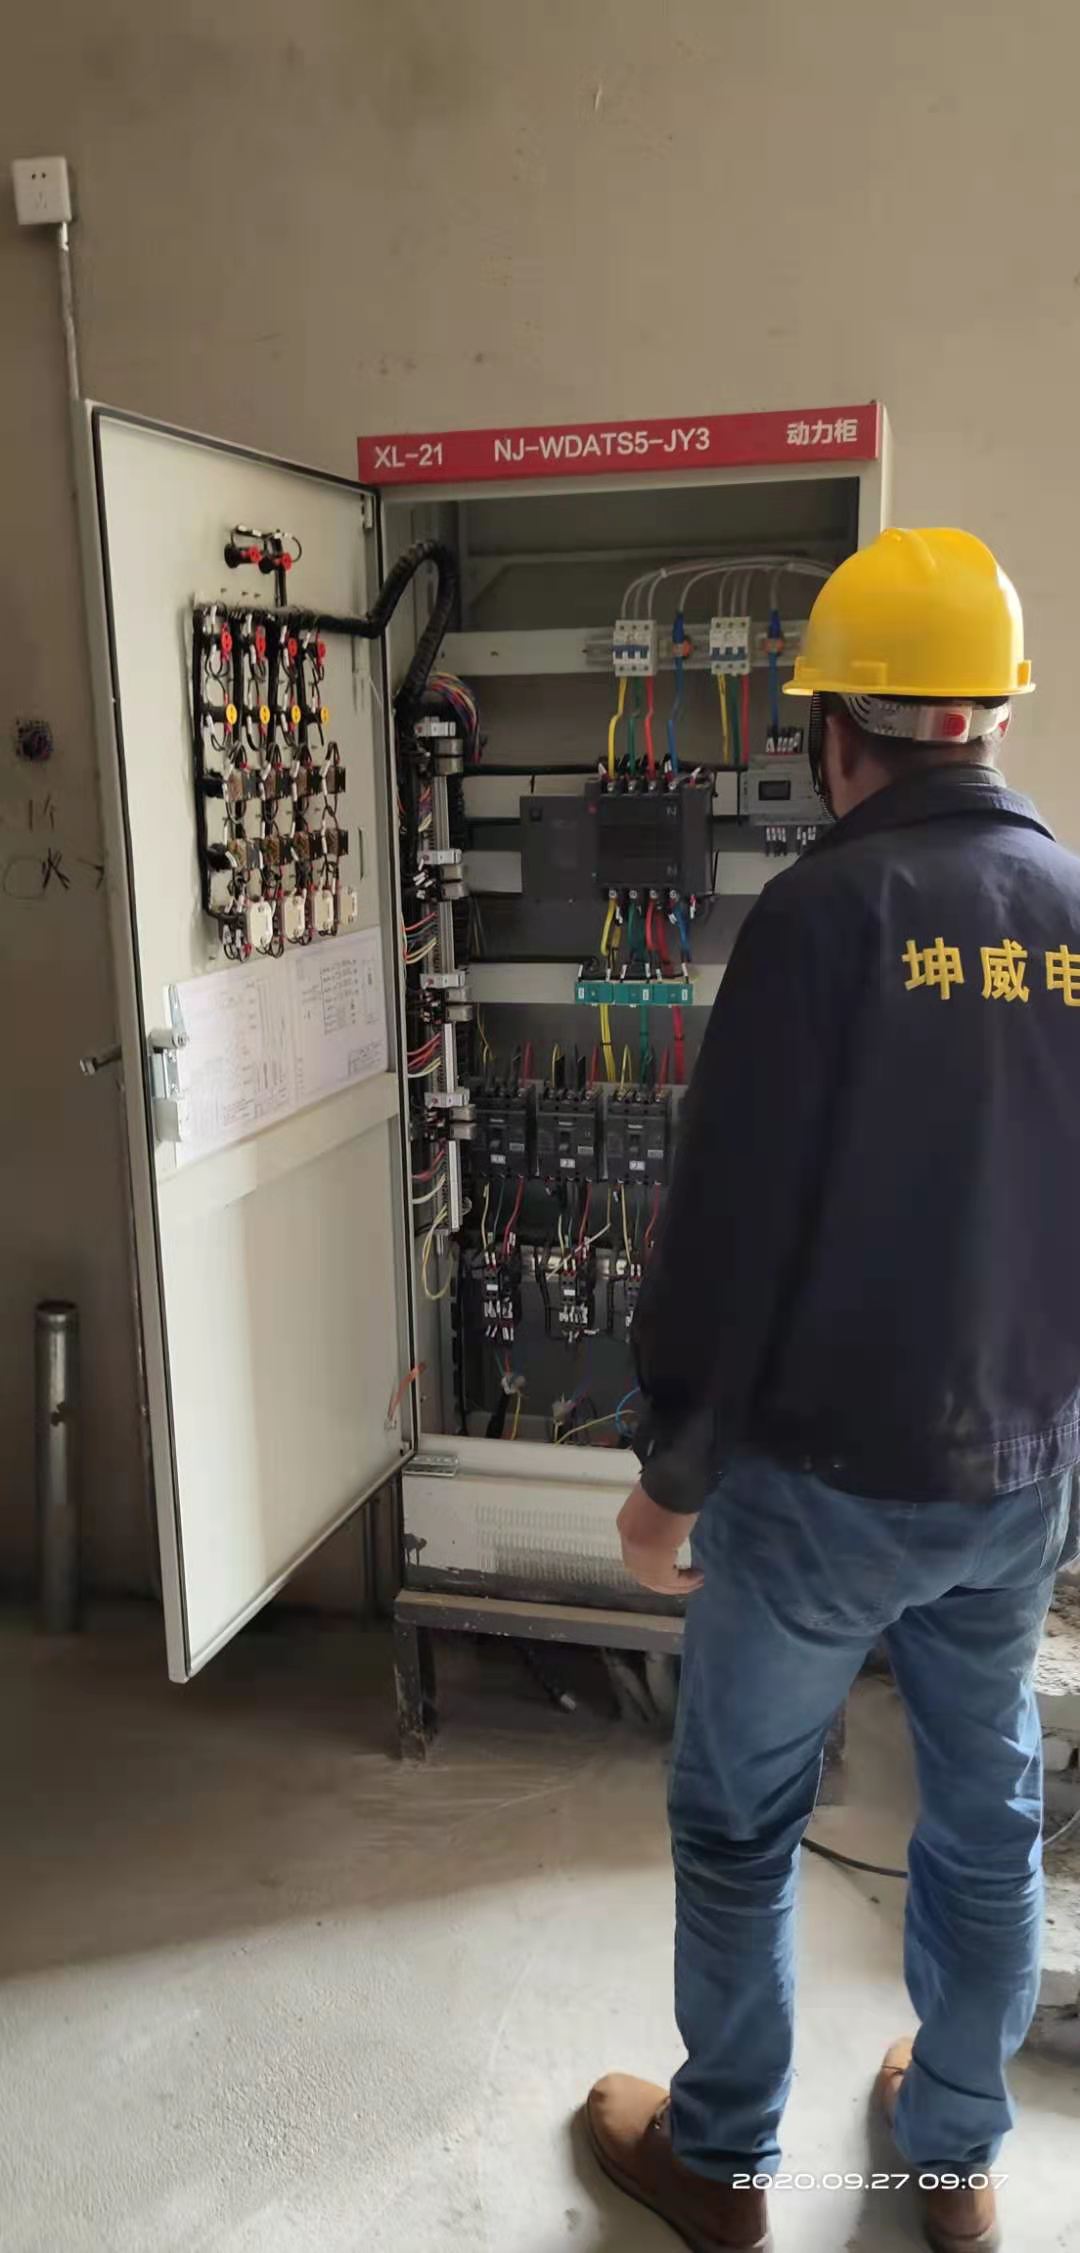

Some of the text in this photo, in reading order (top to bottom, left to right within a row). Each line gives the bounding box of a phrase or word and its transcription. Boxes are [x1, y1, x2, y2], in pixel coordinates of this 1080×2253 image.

[374, 419, 858, 468] XL-21 NJ-WDATS5-JY3 动力柜
[901, 936, 1080, 1007] 坤威电
